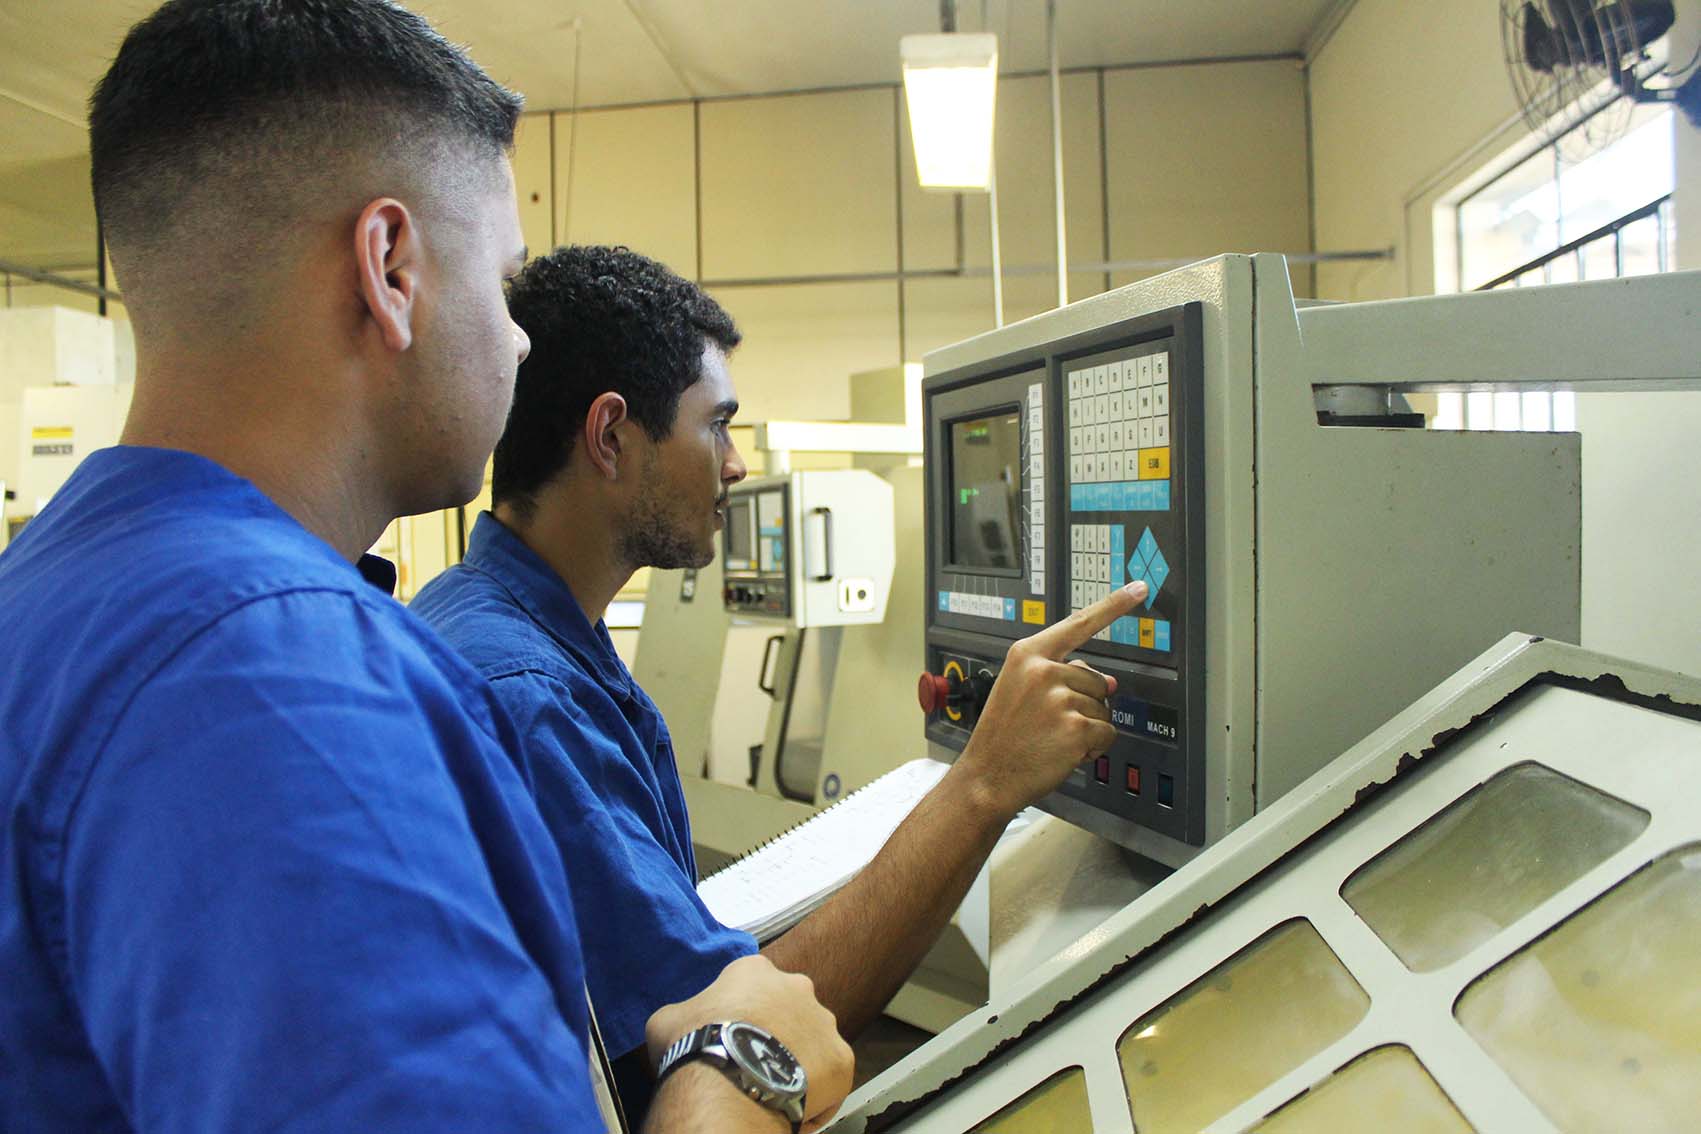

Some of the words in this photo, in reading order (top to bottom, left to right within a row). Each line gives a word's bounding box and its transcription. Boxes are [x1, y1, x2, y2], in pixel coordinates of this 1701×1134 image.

[1112, 709, 1135, 727] ROMI
[1147, 720, 1169, 736] MACH
[1170, 727, 1176, 738] 9
